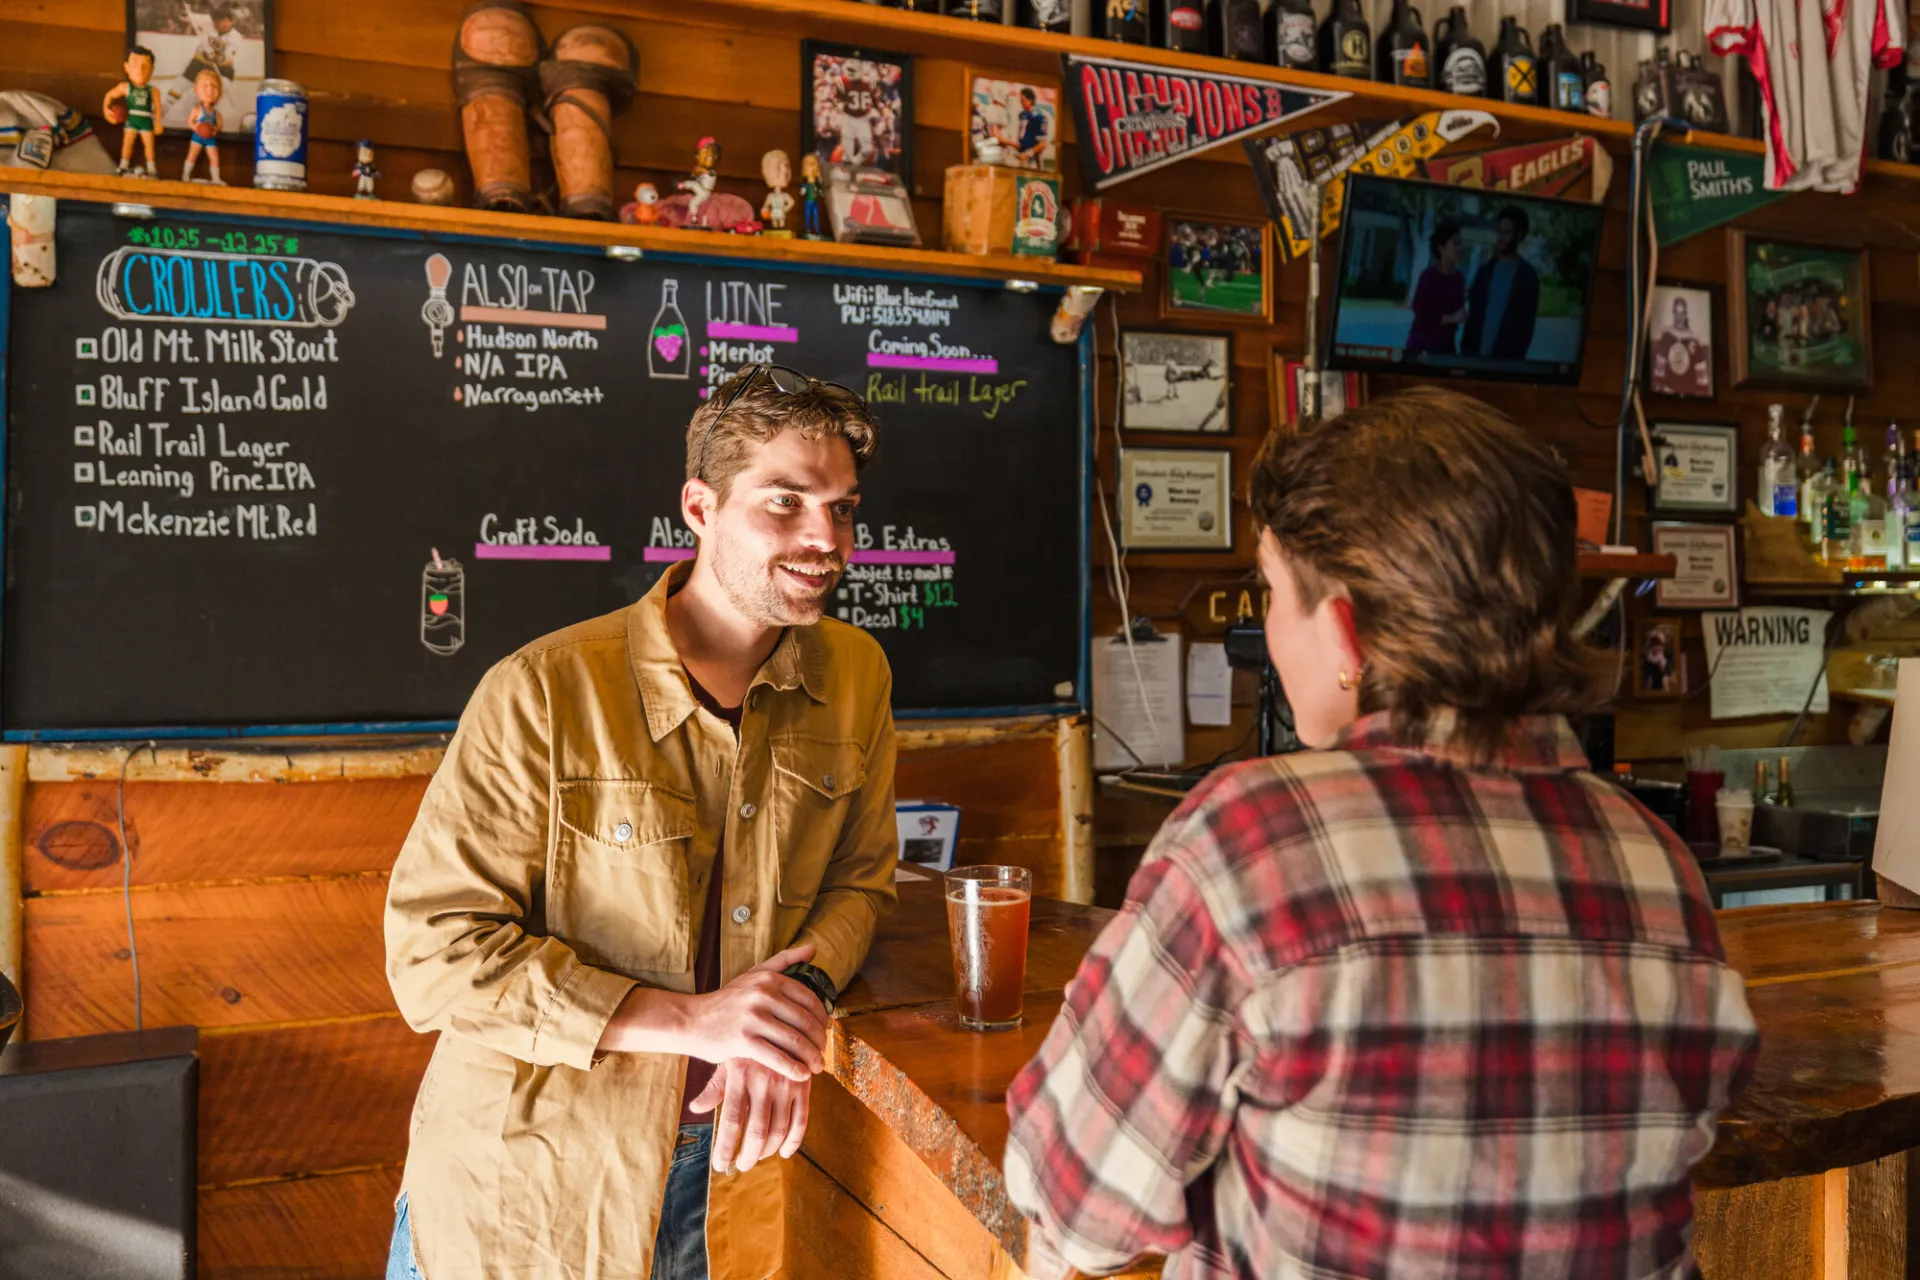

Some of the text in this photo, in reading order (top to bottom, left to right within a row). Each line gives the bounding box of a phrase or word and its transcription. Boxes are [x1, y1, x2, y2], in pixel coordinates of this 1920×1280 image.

[1081, 64, 1263, 174] CHAMPIONS
[1510, 138, 1584, 190] EAGLES
[1687, 160, 1731, 179] PAUL
[123, 253, 295, 321] CROWLERS
[461, 262, 528, 310] ALSO
[540, 266, 595, 314] TAP
[705, 280, 789, 328] WINE
[102, 327, 339, 364] Old Mt. Milk Stout
[466, 325, 598, 351] Hudson North
[709, 340, 775, 363] Merlot
[868, 329, 928, 359] Coming
[464, 350, 568, 380] N/A IPA
[180, 375, 267, 413] Island
[270, 374, 327, 411] Gold
[464, 384, 605, 412] Narragansett
[866, 371, 907, 405] Rail
[969, 375, 1028, 420] Lager
[99, 420, 290, 468] Rail Trail Lager
[99, 461, 316, 498] Leaning Pine IPA
[237, 503, 277, 540] Mt.
[277, 503, 318, 537] Red
[543, 515, 600, 546] Soda
[650, 516, 696, 548] Also
[883, 524, 951, 551] Extras
[844, 563, 893, 584] Subject
[896, 564, 912, 581] to
[848, 582, 959, 607] T-Shirt $12
[851, 603, 924, 629] Decal $4
[1715, 615, 1810, 646] WARNING
